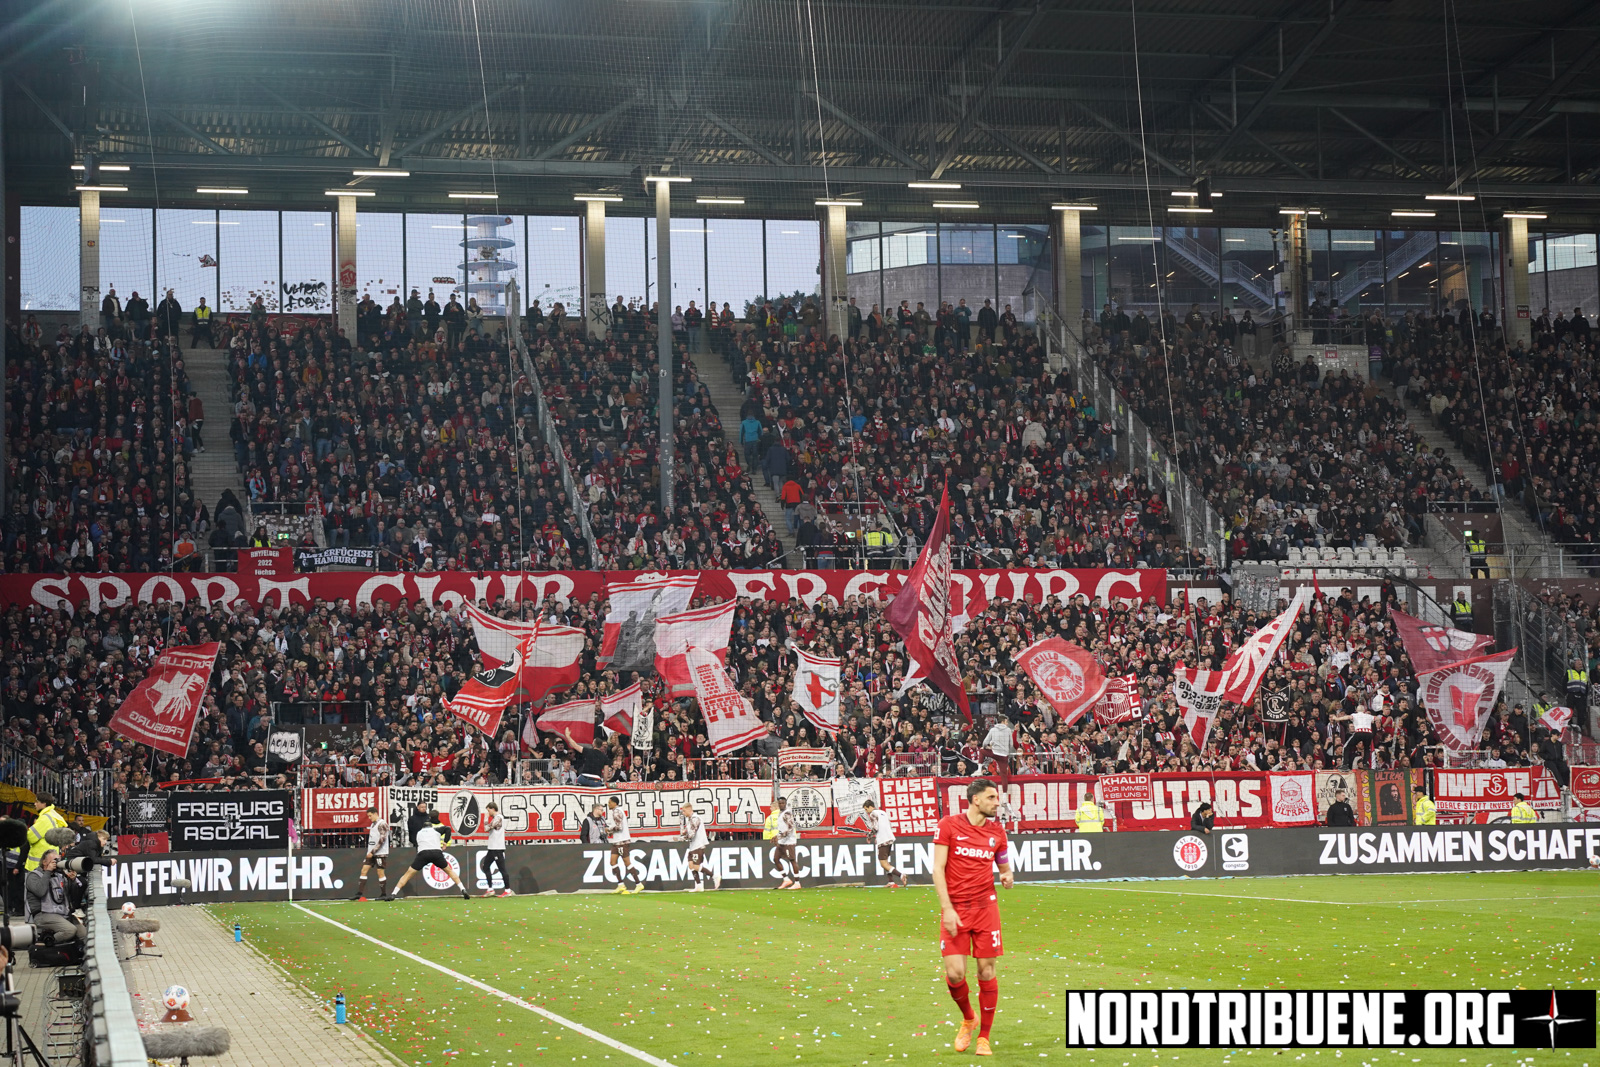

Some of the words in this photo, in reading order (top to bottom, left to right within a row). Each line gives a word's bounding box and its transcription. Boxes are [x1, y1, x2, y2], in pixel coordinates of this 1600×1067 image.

[257, 559, 273, 567] 2022
[314, 555, 358, 565] HAMBURG
[30, 574, 311, 619] SPORT
[355, 573, 576, 612] CLUB
[882, 778, 934, 794] FUSS
[1102, 776, 1148, 786] KHALID
[1103, 784, 1119, 793] FÜR
[1437, 772, 1491, 797] IWF
[1504, 772, 1530, 797] 12
[316, 791, 375, 810] EKSTASE
[390, 788, 438, 803] SCHEISS
[884, 792, 936, 808] BALL
[885, 805, 925, 821] DEN
[1274, 805, 1310, 817] ULTRAS
[1436, 801, 1463, 810] IDEALE
[1464, 802, 1487, 810] STATT
[333, 814, 359, 824] ULTRAS
[890, 819, 938, 835] FANS
[954, 846, 995, 860] JOBRAD
[1318, 830, 1483, 865] ZUSAMMEN
[1488, 828, 1600, 862] SCHAFF
[582, 846, 763, 884] ZUSAMMEN
[1007, 839, 1103, 873] MEHR.
[188, 858, 233, 892] WIR
[239, 855, 344, 891] MEHR.
